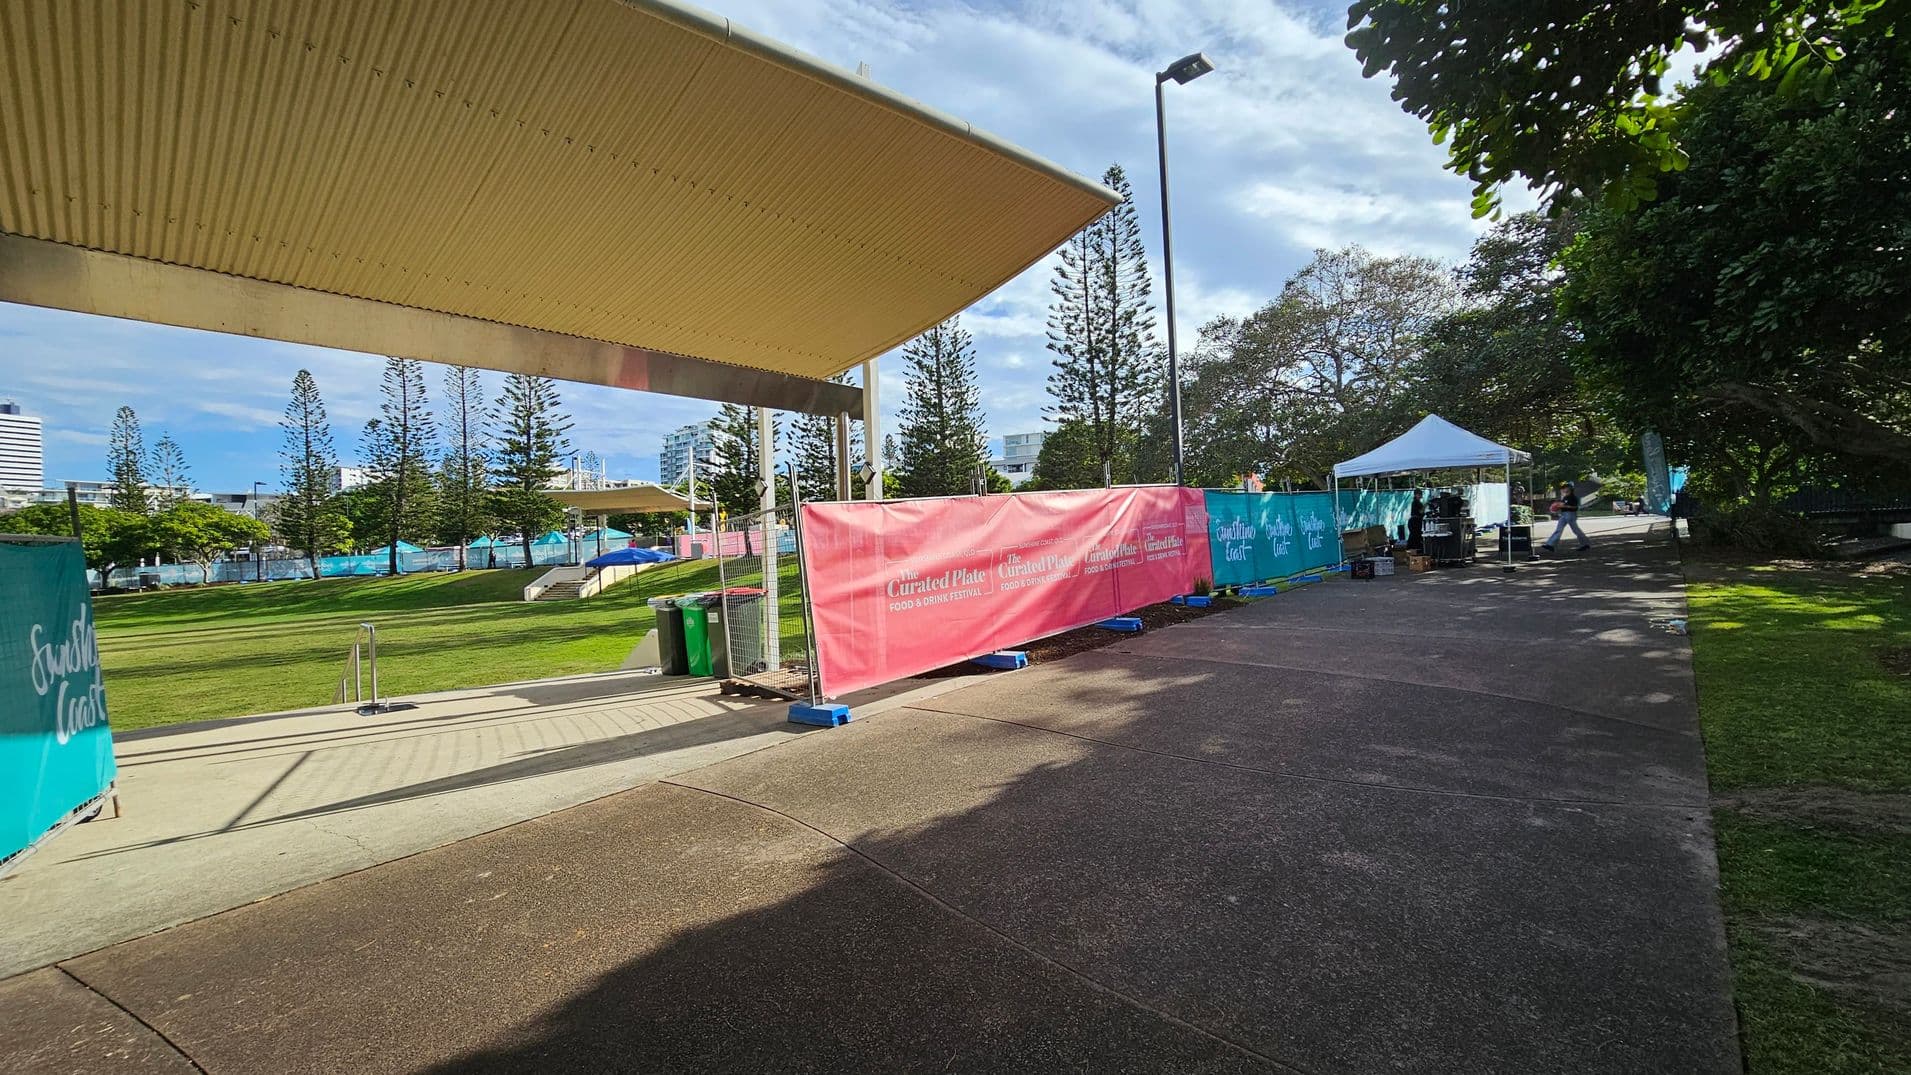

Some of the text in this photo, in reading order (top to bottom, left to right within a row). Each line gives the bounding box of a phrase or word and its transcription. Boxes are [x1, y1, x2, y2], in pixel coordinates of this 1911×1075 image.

[998, 554, 1074, 579] Curated Plate
[1006, 553, 1022, 564] The
[887, 567, 985, 598] Curated Plate
[900, 568, 920, 581] The
[1001, 580, 1020, 592] FOOD
[1027, 575, 1046, 586] DRINK
[889, 587, 983, 612] FOOD & DRINK FESTIVAL
[56, 681, 106, 745] Coast
